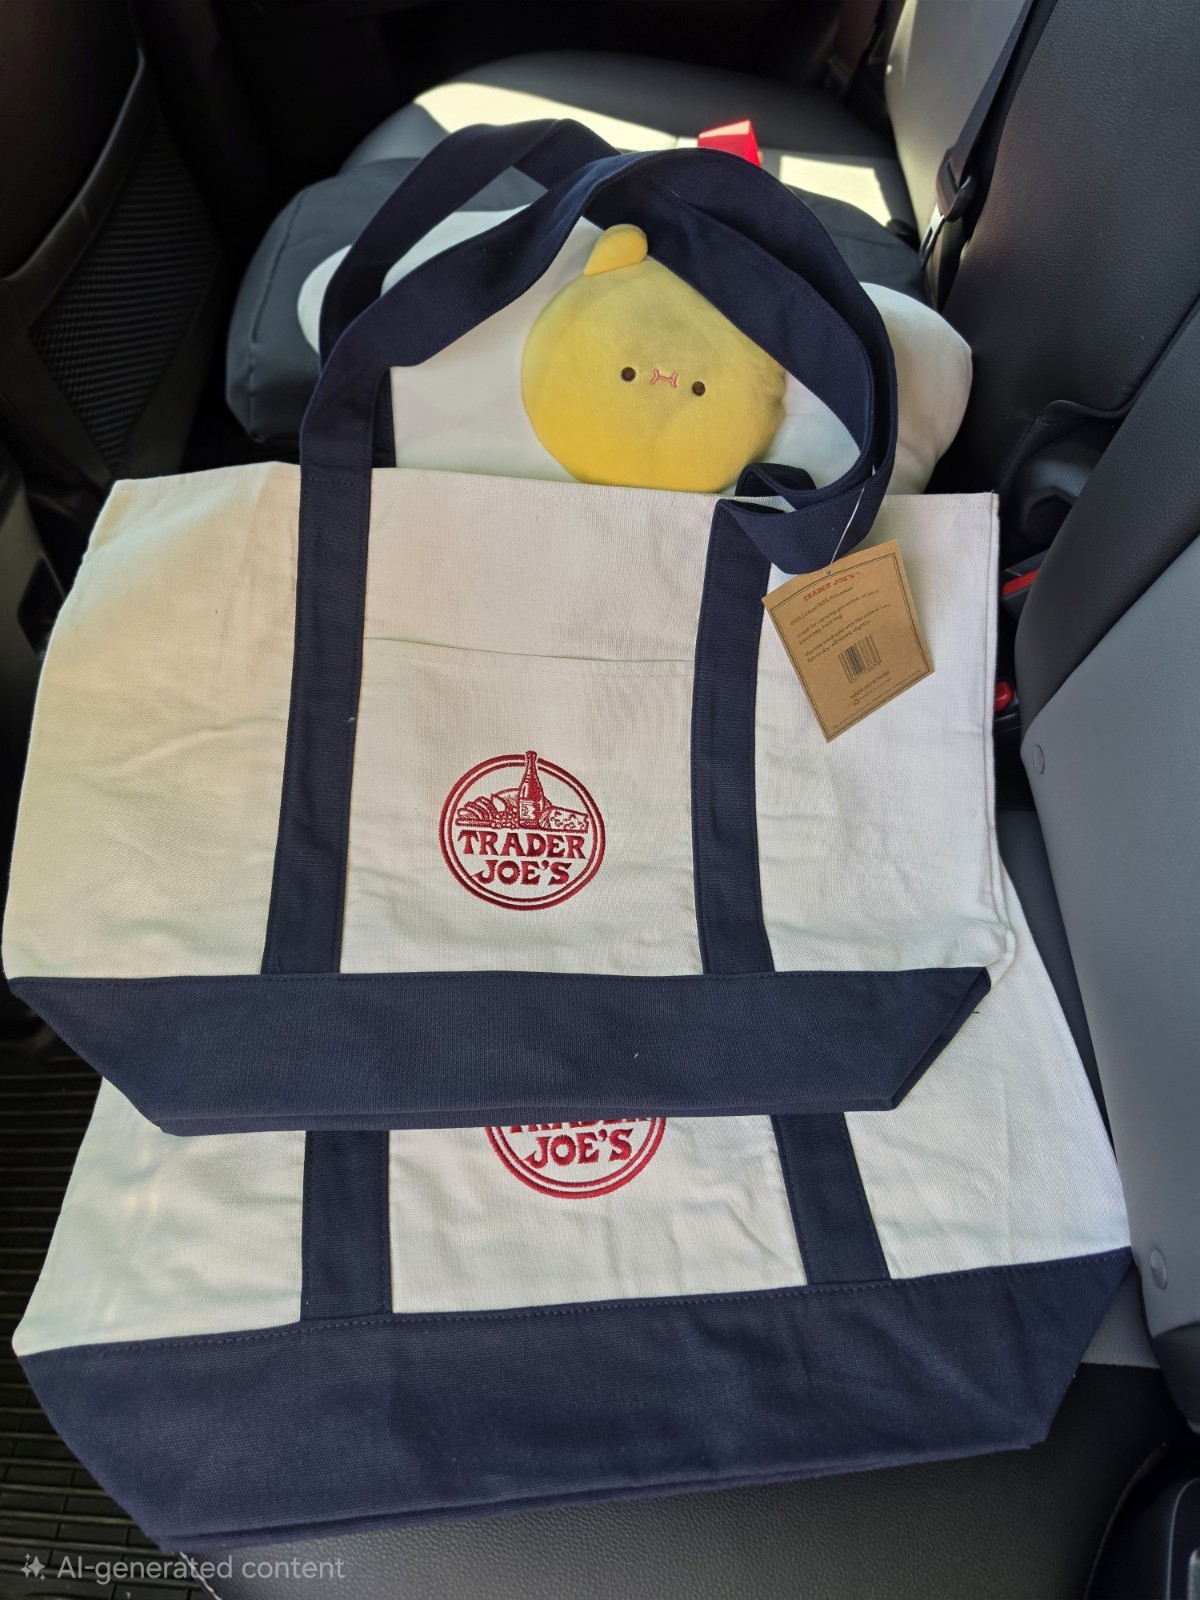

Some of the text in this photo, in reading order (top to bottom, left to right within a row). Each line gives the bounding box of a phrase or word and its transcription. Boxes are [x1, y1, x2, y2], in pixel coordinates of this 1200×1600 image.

[803, 582, 831, 601] TRADER
[457, 830, 586, 859] TRADER
[471, 859, 572, 885] JOE'S
[523, 1128, 634, 1169] JOE'S
